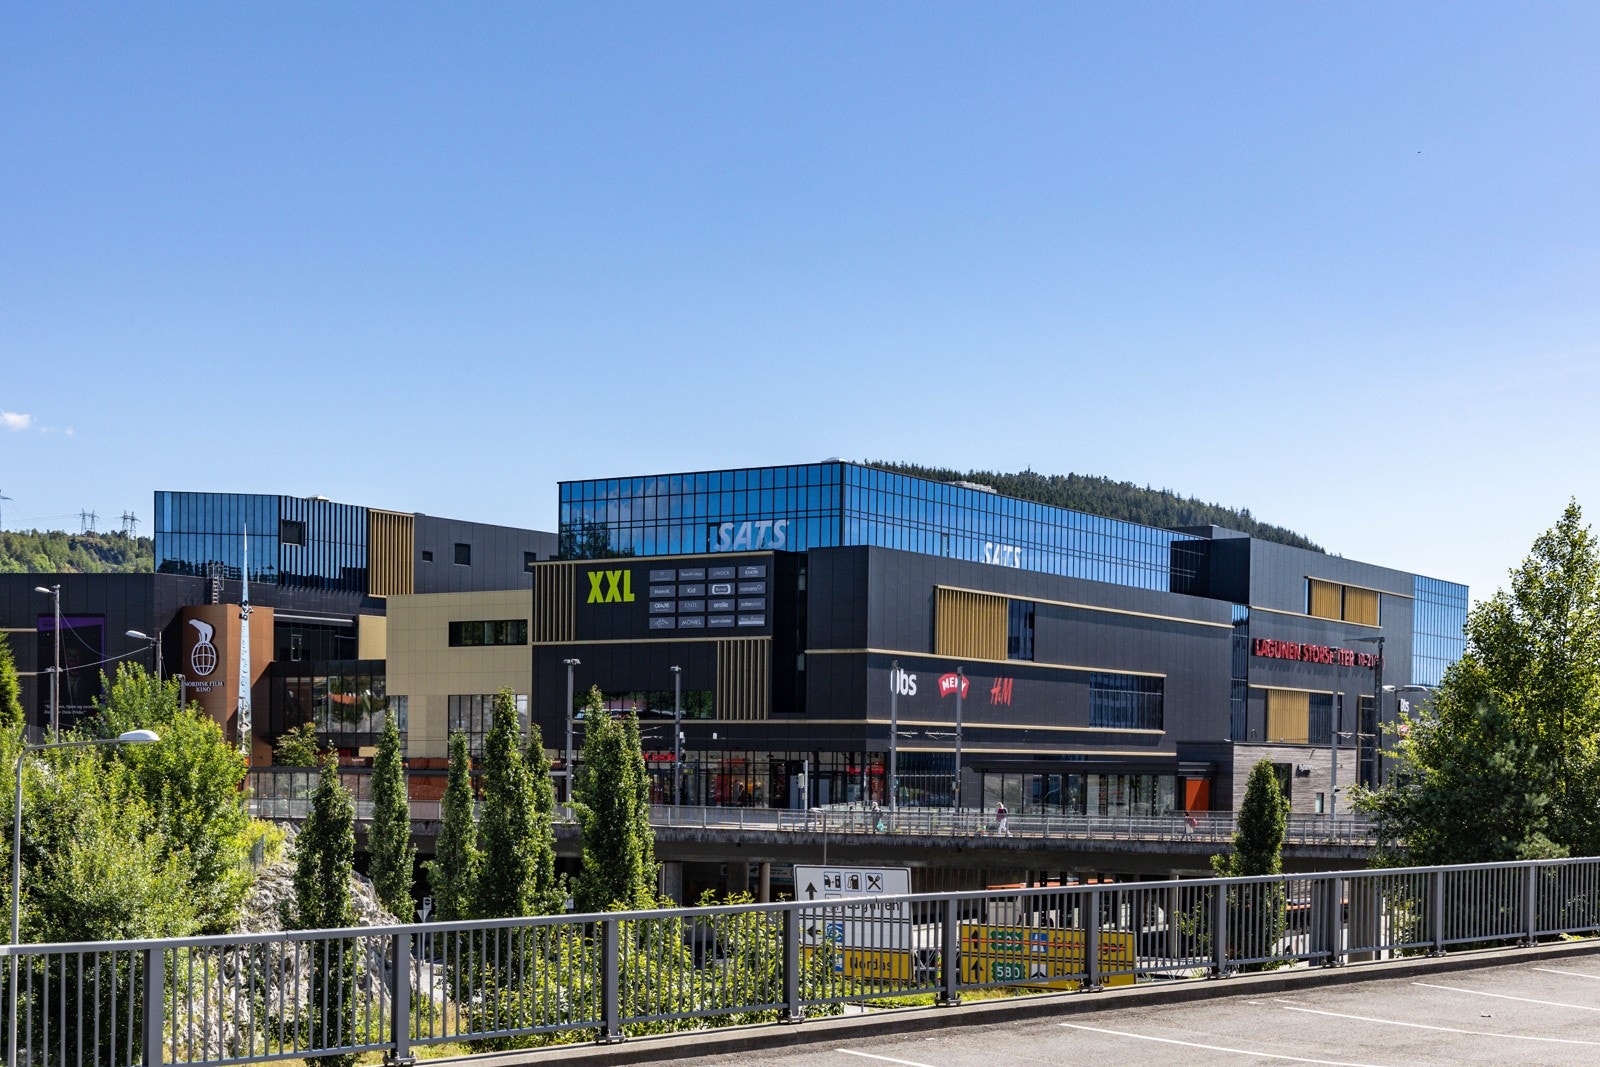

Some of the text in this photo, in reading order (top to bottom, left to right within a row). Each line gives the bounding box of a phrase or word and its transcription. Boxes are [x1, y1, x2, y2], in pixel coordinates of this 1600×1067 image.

[714, 520, 790, 551] SATS
[982, 541, 1022, 568] SATS
[587, 570, 635, 603] XXL
[1255, 639, 1301, 661] LAGUNEN
[991, 677, 1013, 706] H&M
[997, 966, 1020, 978] 580
